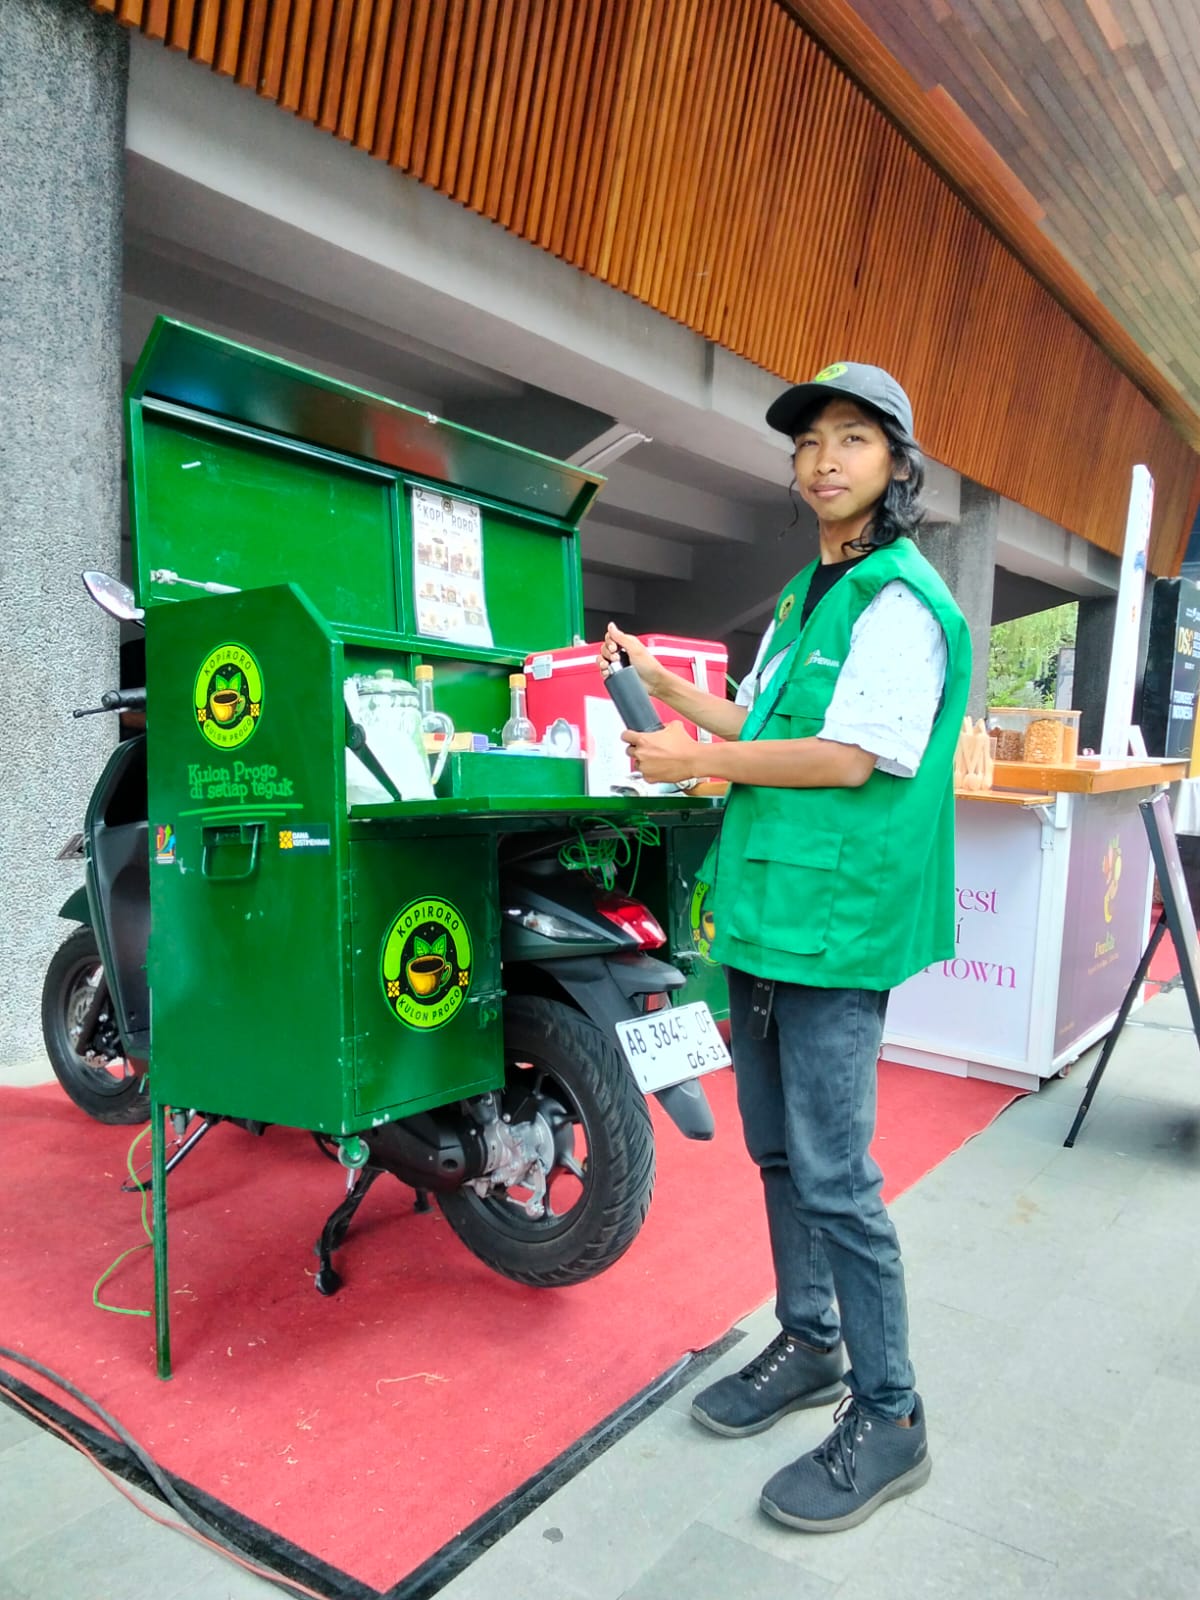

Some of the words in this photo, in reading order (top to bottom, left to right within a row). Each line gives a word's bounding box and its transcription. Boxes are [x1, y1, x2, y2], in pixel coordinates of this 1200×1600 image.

[204, 651, 252, 676] KOPIRORO
[229, 719, 252, 742] PROGO
[187, 764, 230, 784] Kulon
[233, 760, 278, 782] Progo
[190, 782, 203, 799] di
[207, 782, 248, 804] setiap
[251, 777, 294, 799] teguk
[397, 906, 459, 938] KOPIRORO
[398, 998, 429, 1021] KULON
[432, 989, 460, 1020] PROGO
[626, 1028, 647, 1056] AB
[649, 1016, 688, 1049] 3845
